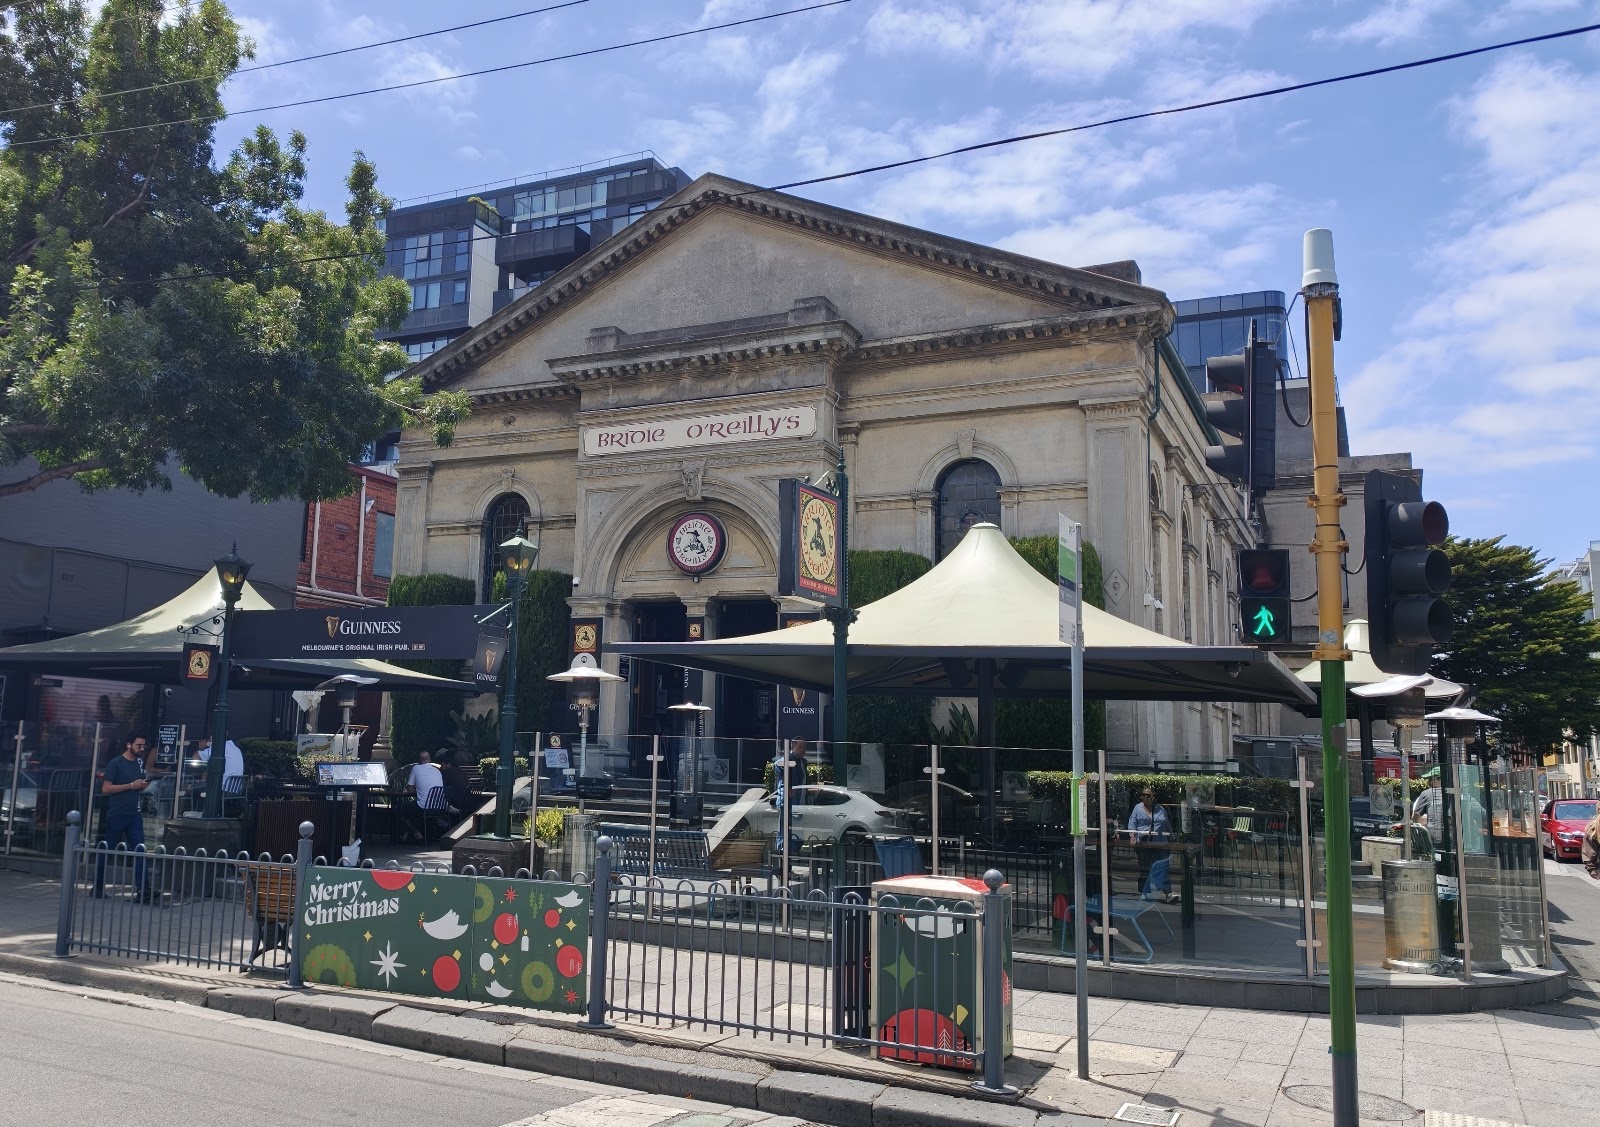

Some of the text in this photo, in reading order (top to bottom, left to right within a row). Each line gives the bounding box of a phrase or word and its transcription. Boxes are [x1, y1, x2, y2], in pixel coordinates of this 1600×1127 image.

[339, 619, 402, 635] GUINNESS
[782, 706, 815, 715] GUINNESS
[309, 880, 363, 904] Merry
[304, 897, 400, 927] Christmas
